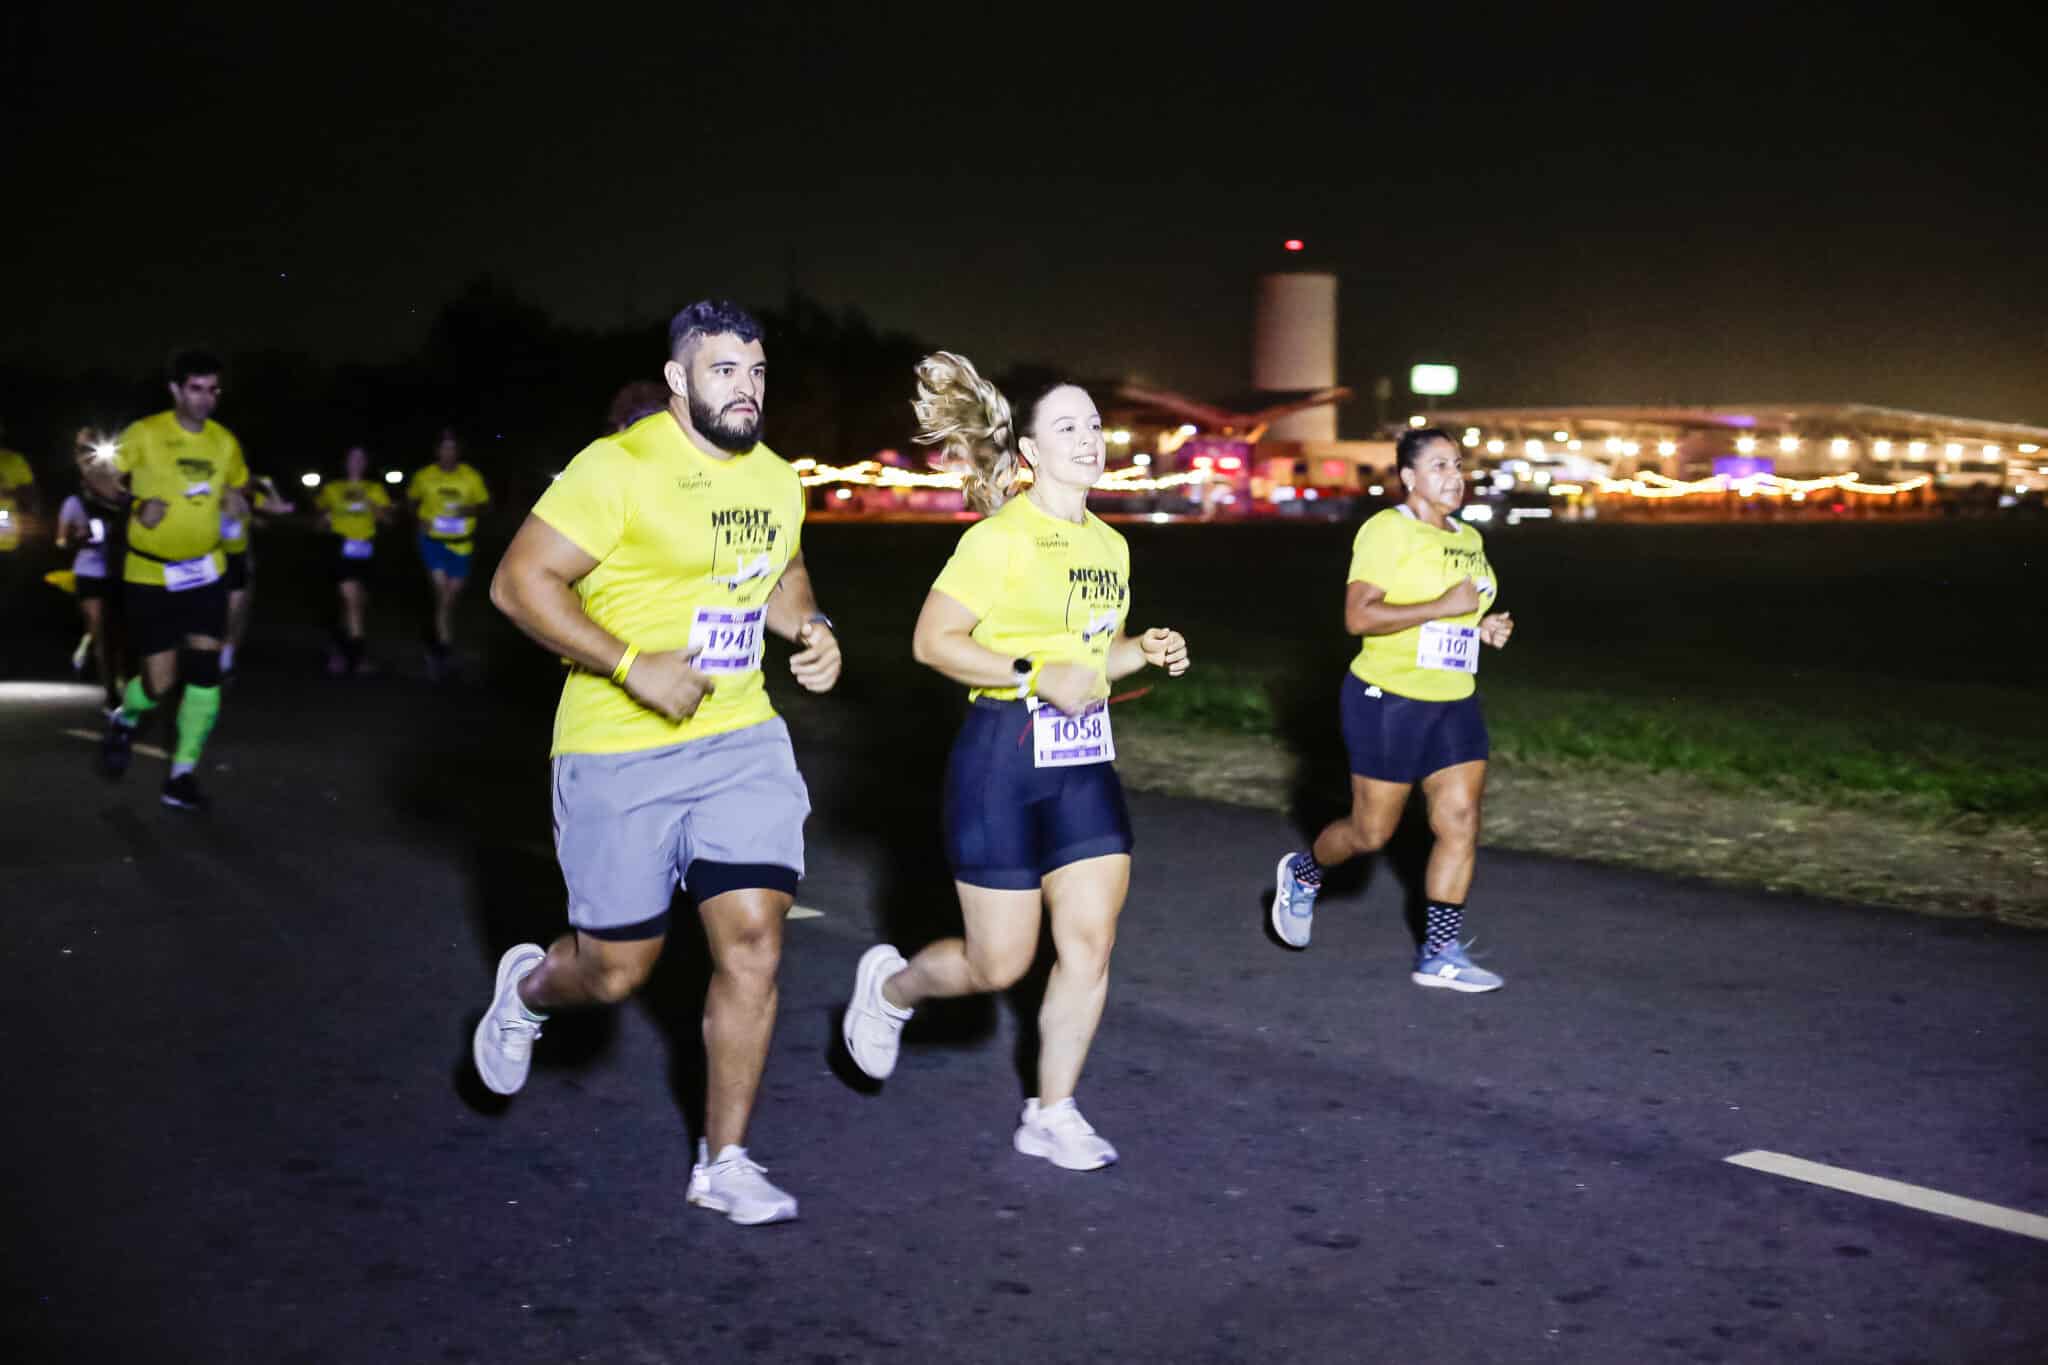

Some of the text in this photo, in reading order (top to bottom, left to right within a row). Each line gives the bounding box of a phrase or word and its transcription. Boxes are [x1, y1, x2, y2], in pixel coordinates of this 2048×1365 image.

[711, 508, 771, 528] NIGHT
[1068, 567, 1118, 585] NIGHT
[1051, 717, 1102, 743] 1058
